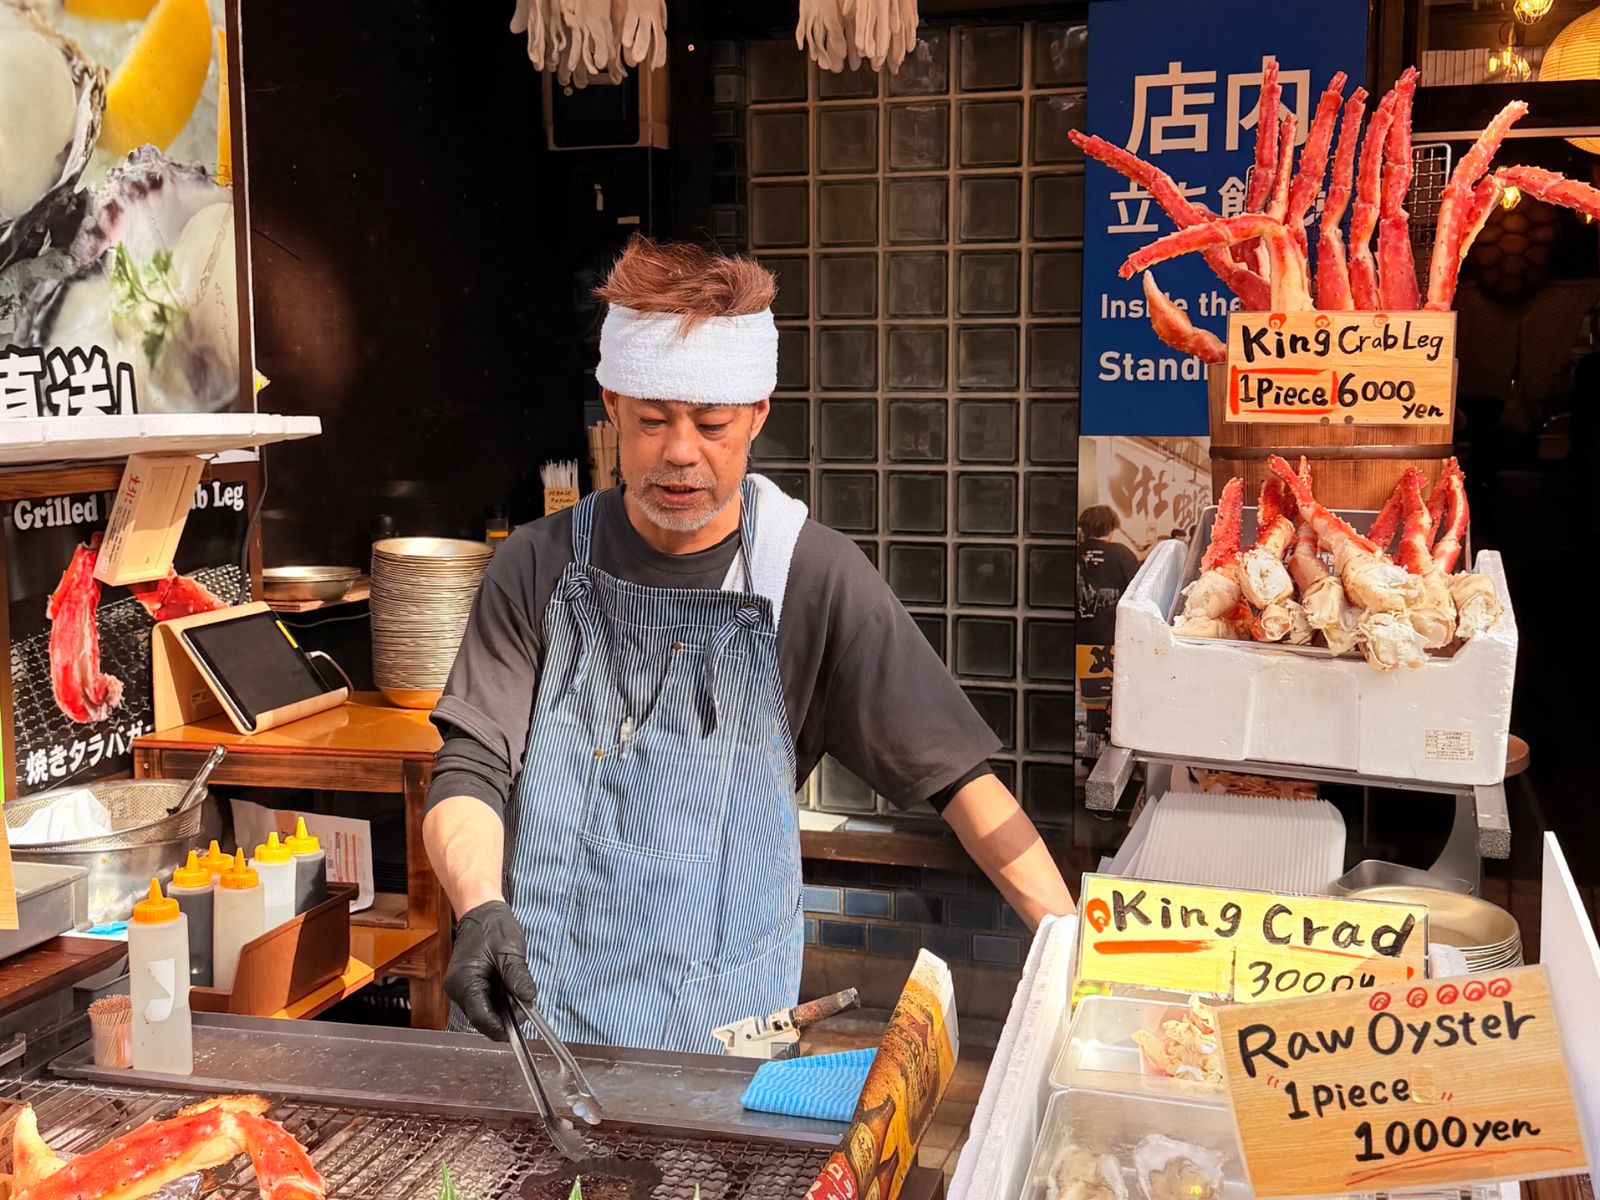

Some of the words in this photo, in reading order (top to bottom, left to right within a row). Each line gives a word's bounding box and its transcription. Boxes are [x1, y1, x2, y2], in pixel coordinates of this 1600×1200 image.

[1125, 55, 1310, 155] 店内
[1242, 324, 1332, 363] King
[1338, 323, 1399, 354] Crab
[1403, 320, 1444, 361] Leg
[1338, 373, 1415, 407] 6000
[1402, 403, 1444, 419] yen
[14, 497, 99, 530] Grilled
[212, 481, 244, 511] Leg
[1112, 889, 1242, 938] King
[1262, 903, 1416, 957] Crad
[1238, 1024, 1354, 1078] Raw
[1368, 1001, 1535, 1054] Oyster
